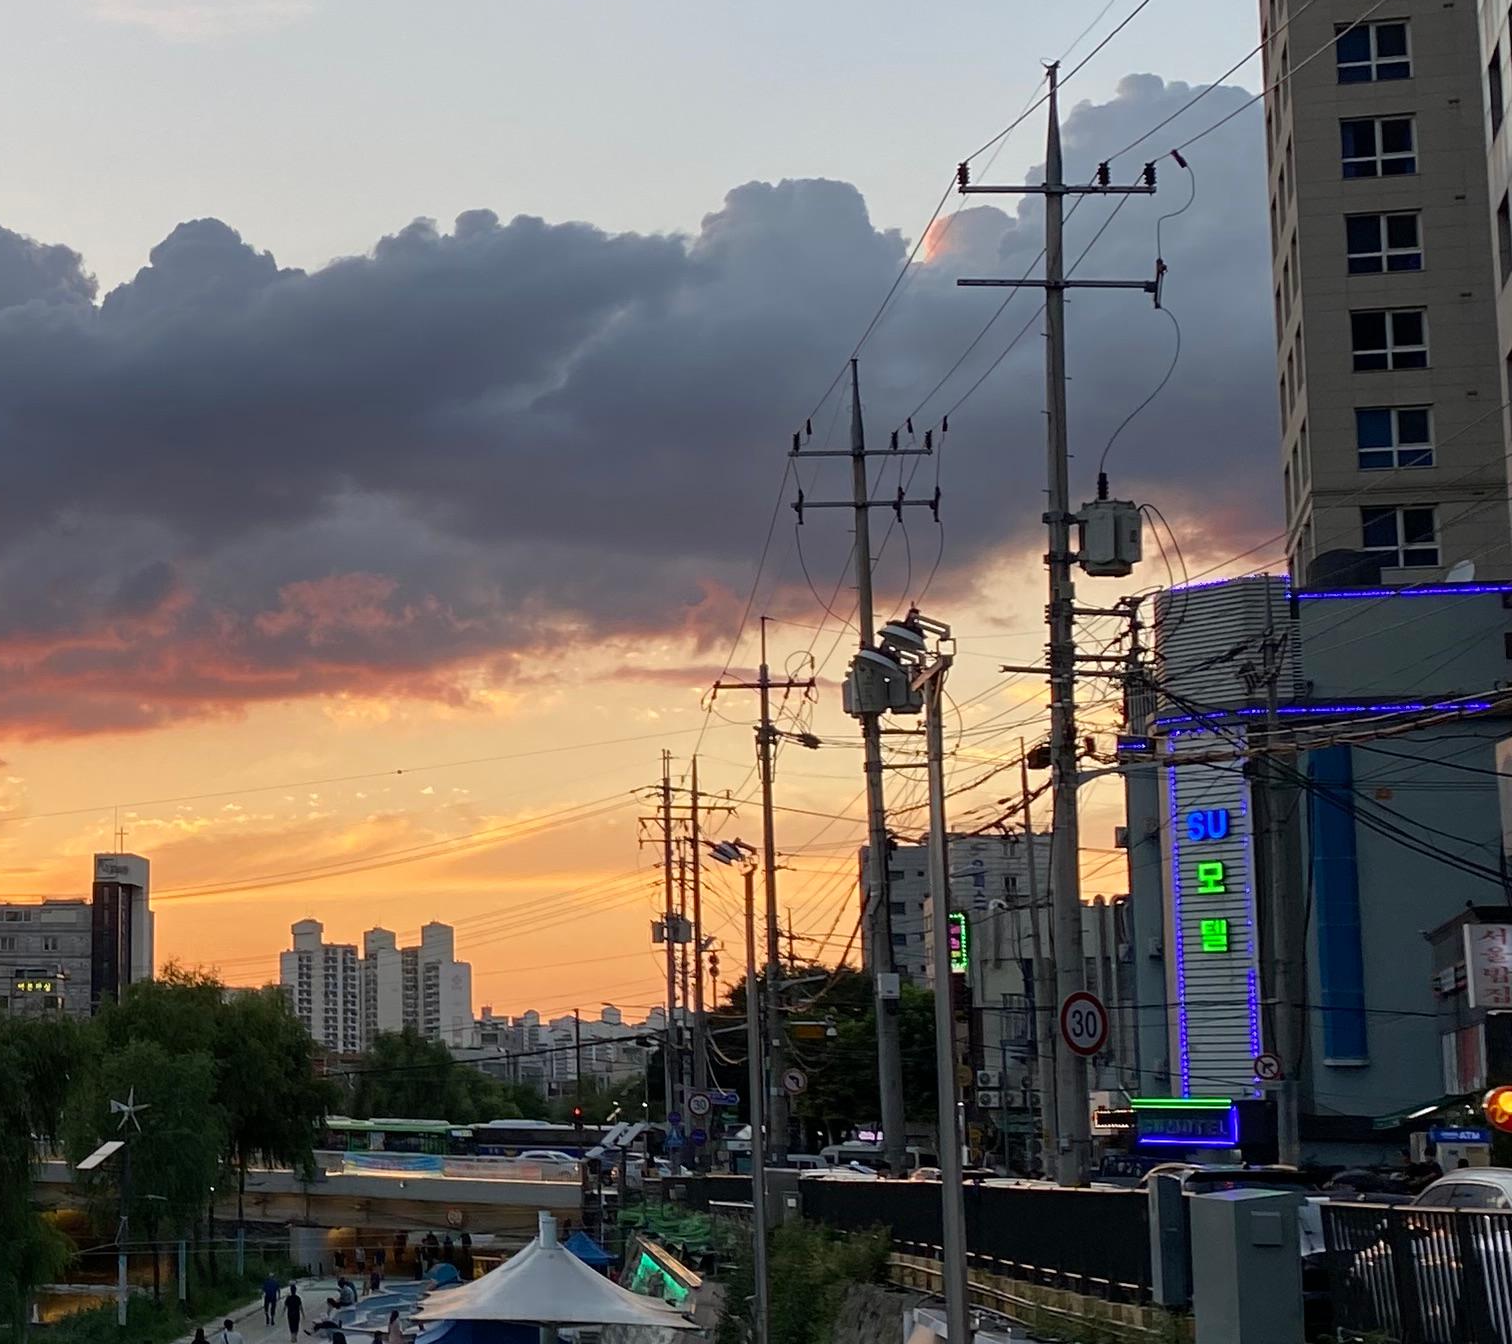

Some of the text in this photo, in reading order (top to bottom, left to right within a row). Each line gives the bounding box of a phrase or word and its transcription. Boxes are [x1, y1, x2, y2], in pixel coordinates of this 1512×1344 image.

[1187, 808, 1228, 841] SU
[1197, 860, 1228, 953] 모텔
[1072, 1010, 1097, 1038] 30
[693, 1099, 707, 1110] 30
[1459, 1131, 1480, 1140] ATM
